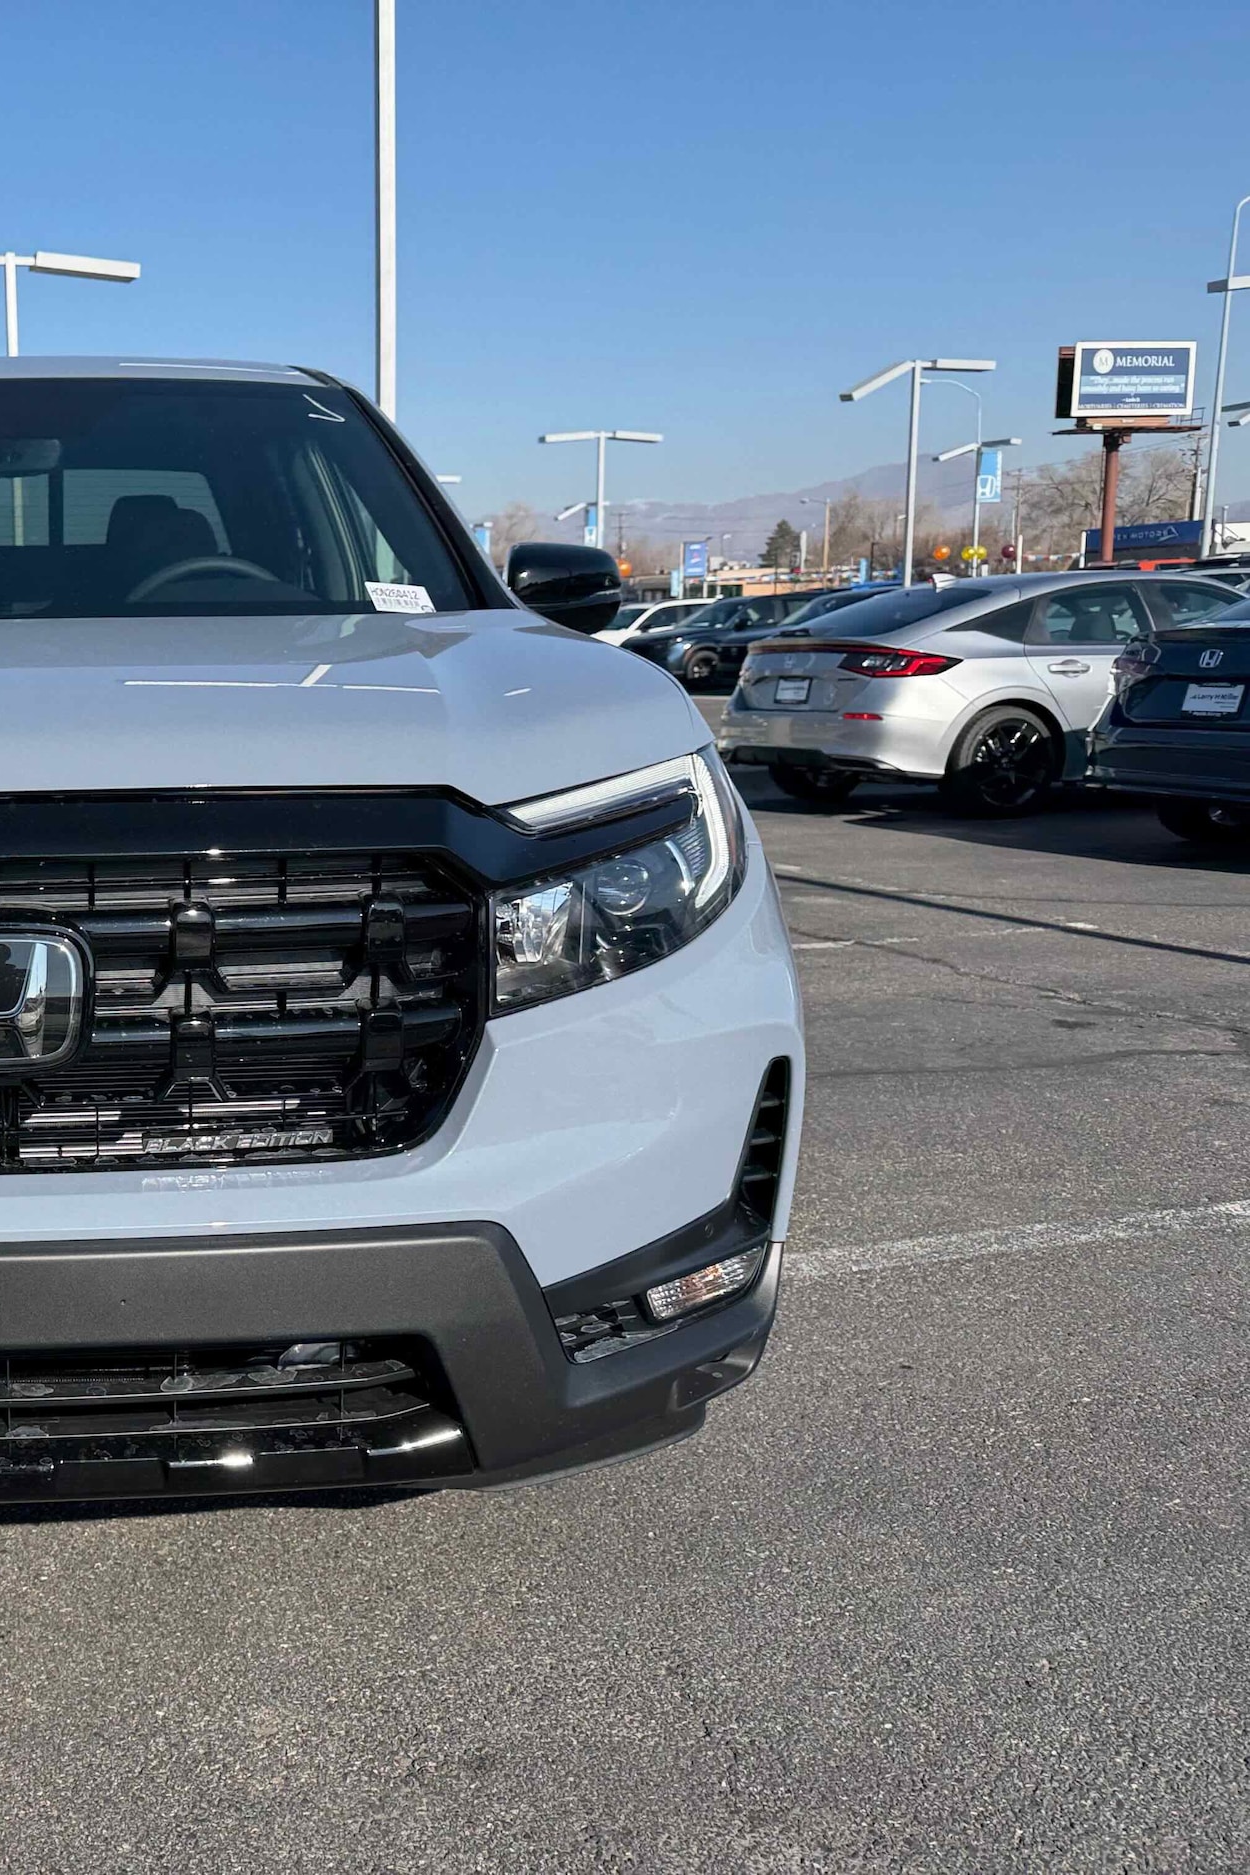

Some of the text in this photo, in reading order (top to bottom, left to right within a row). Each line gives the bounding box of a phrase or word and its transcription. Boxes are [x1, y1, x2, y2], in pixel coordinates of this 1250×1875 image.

[1115, 355, 1175, 367] MEMORIAL
[144, 1129, 333, 1152] BLACK EDITION
